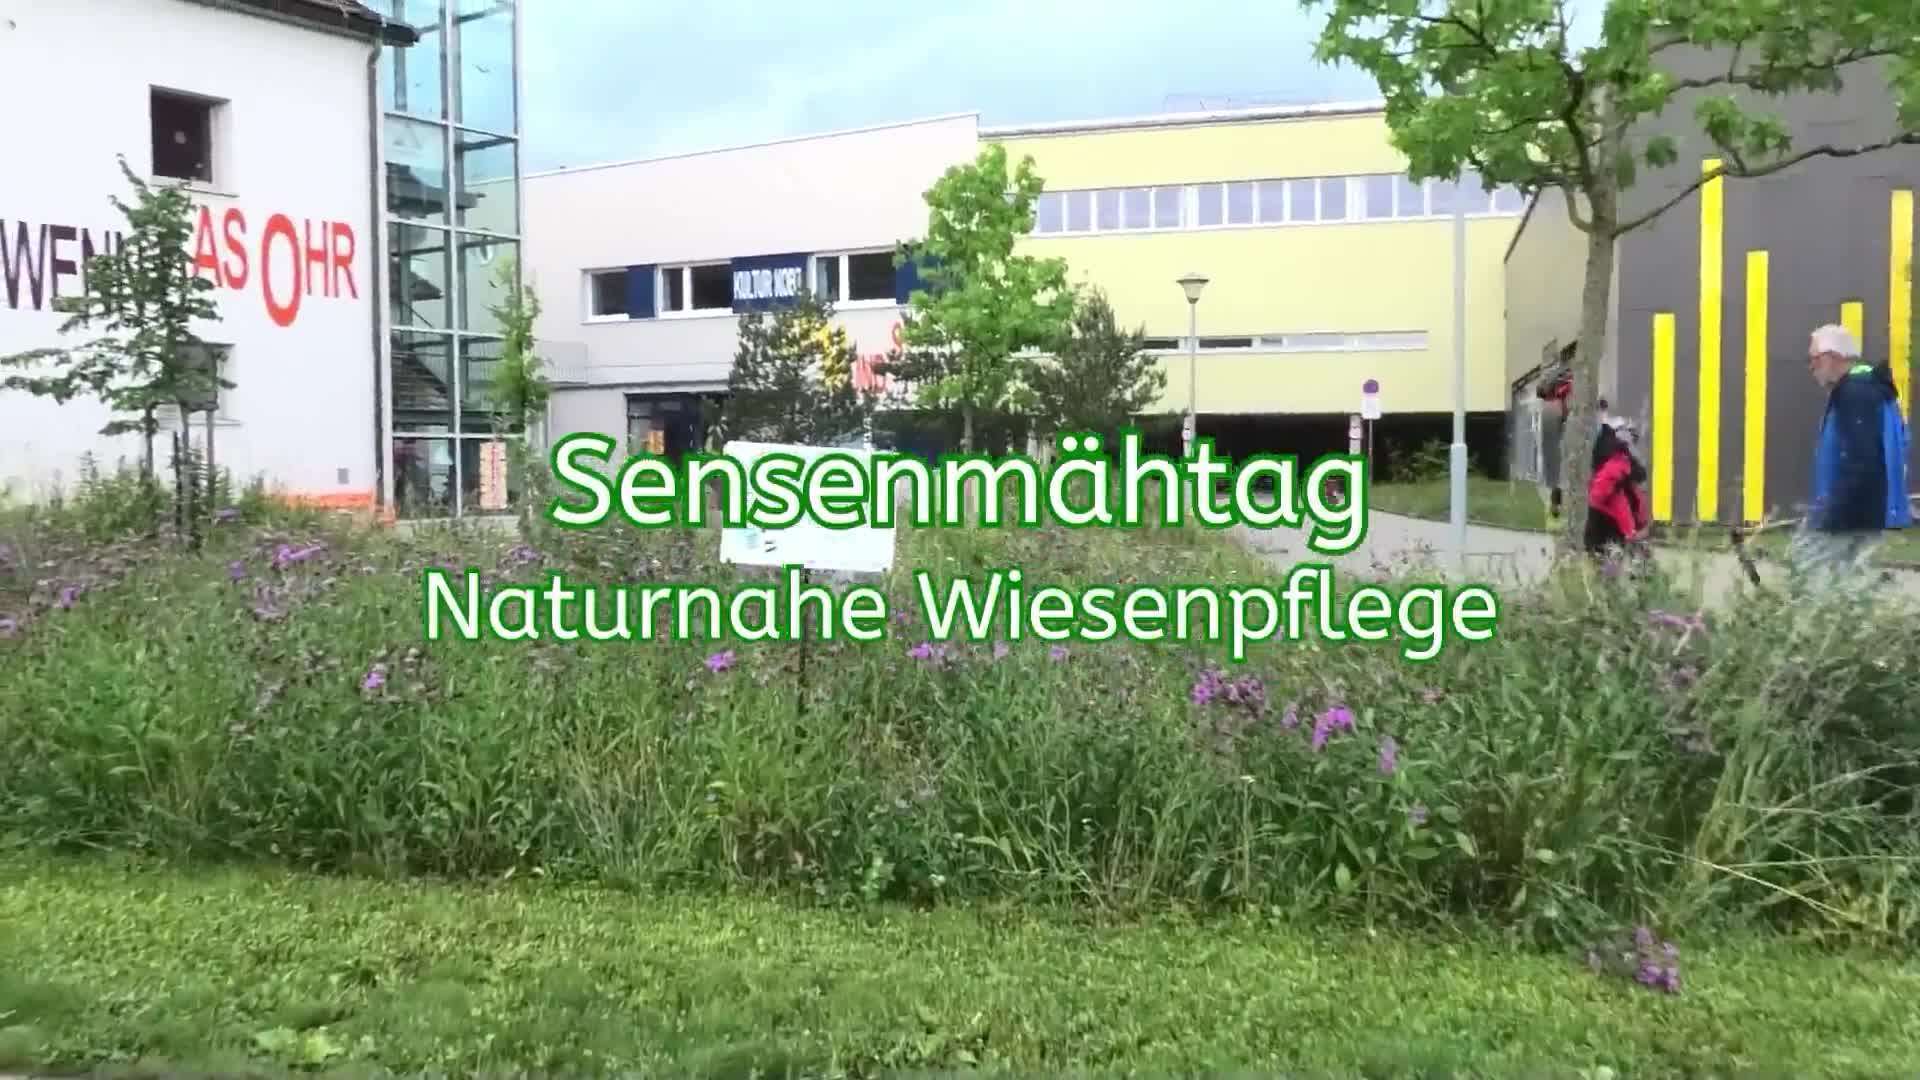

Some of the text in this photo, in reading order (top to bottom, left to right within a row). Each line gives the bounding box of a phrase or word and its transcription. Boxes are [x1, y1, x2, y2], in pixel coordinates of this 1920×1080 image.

[0, 205, 358, 327] WEN AS OHR
